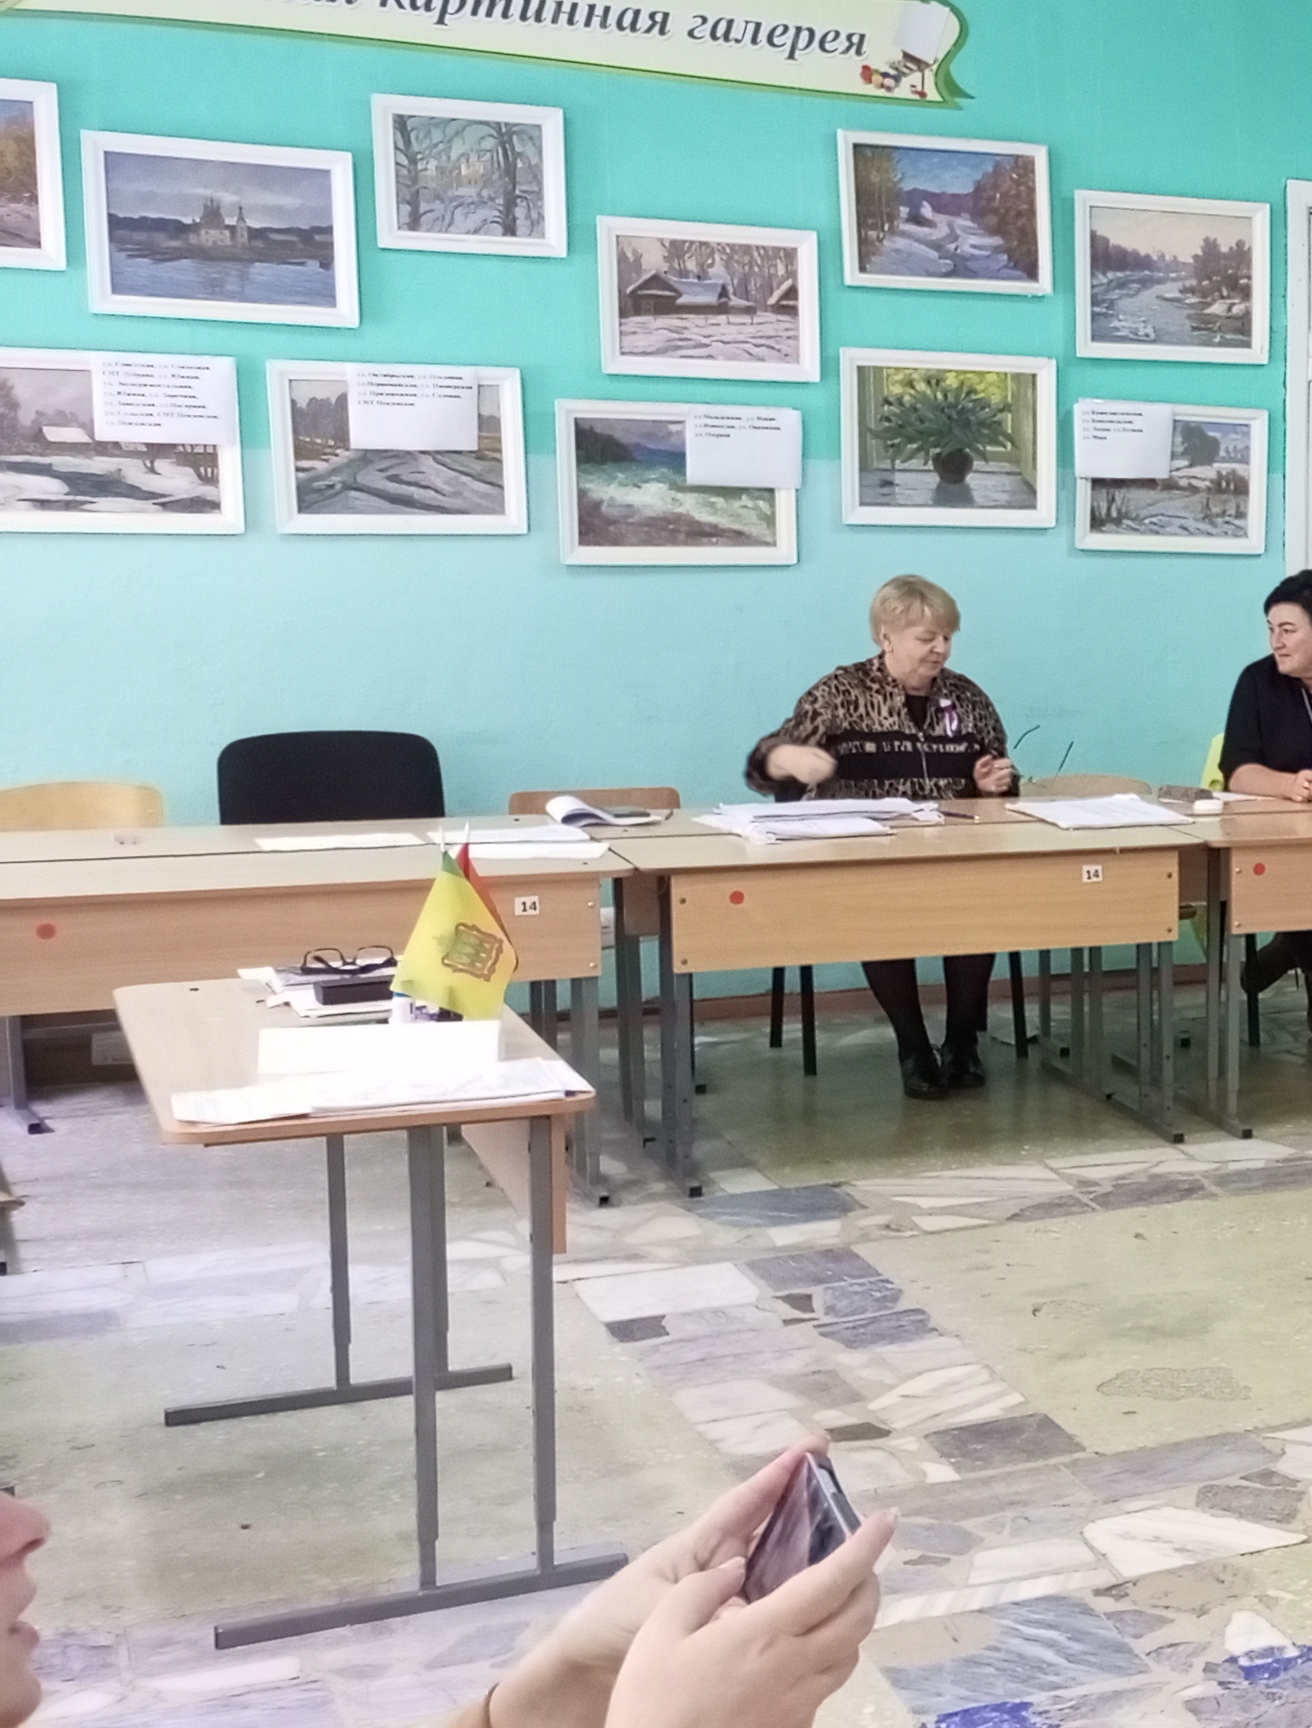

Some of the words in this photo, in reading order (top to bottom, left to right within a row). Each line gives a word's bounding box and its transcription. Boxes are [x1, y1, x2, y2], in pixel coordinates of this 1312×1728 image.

[686, 14, 867, 61] галерея
[1085, 869, 1100, 880] 14
[521, 900, 538, 912] 14
